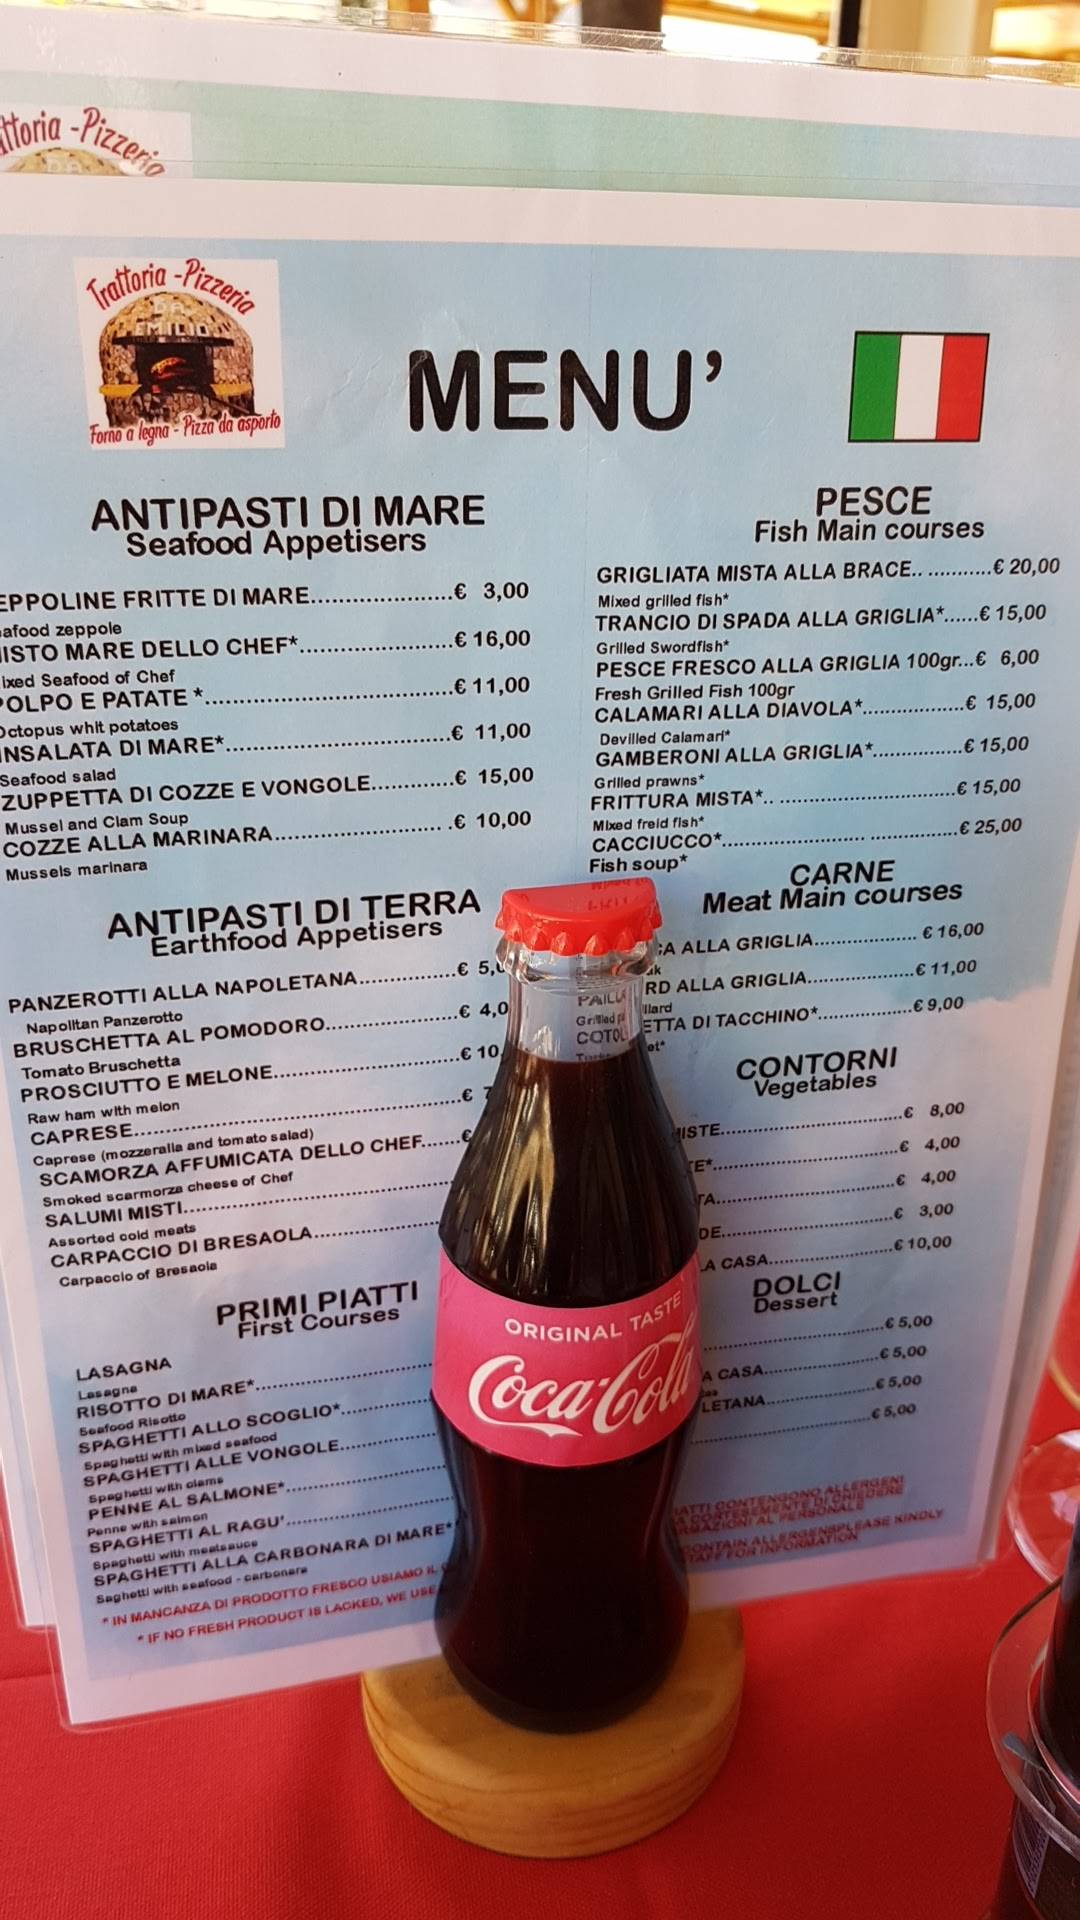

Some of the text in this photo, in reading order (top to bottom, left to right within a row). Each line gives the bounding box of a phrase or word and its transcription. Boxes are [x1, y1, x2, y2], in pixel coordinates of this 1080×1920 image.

[86, 263, 167, 310] Trattoria
[90, 409, 281, 446] Forno legna Pizza da asporto
[91, 494, 485, 532] ANTIPASTI DI MARE
[816, 485, 933, 517] PESCE
[754, 518, 985, 543] Fish Main courses
[126, 528, 427, 561] Seafood Appetisers
[597, 565, 710, 584] GRIGLIATA
[717, 564, 778, 582] MISTA
[783, 563, 837, 581] ALLA
[123, 588, 207, 609] FRITTE
[55, 621, 122, 639] zeppole
[594, 610, 848, 632] TRANCIO SPADA ALLA
[65, 638, 219, 661] MARE DELLO
[41, 668, 176, 687] Seafood Chef
[596, 660, 666, 678] PESCE
[672, 658, 756, 676] FRESCO
[761, 657, 813, 674] ALLA
[819, 654, 900, 672] GRIGLIA
[102, 688, 188, 709] PATATE
[595, 682, 796, 701] Fresh Grilled Fish 100gr
[595, 703, 760, 724] CALAMARI ALLA
[109, 718, 179, 736] potatoes
[595, 746, 776, 768] GAMBERONI ALLA
[0, 767, 116, 788] Seafood salad
[1, 787, 123, 812] ZUPPETTA
[159, 782, 235, 802] COZZE
[591, 792, 689, 811] FRITTURA
[5, 819, 64, 835] Mussel
[67, 816, 98, 831] and
[148, 812, 189, 827] Soup
[3, 837, 82, 858] COZZE
[87, 832, 147, 852] ALLA
[5, 861, 148, 882] Mussels marinara
[790, 859, 896, 887] CARNE
[702, 884, 963, 915] Meat Main courses
[107, 888, 481, 940] ANTIPASTI DI TERRA
[151, 921, 443, 957] Earthfood Appetisers
[681, 938, 730, 955] ALLA
[676, 976, 725, 993] ALLA
[8, 988, 147, 1014] PANZEROTTI
[152, 982, 209, 1002] ALLA
[103, 1011, 183, 1028] Panzerotto
[13, 1032, 161, 1058] BRUSCHETTA
[20, 1055, 181, 1080] Tomato Bruschetta
[736, 1046, 897, 1081] CONTORNI
[20, 1076, 161, 1103] PROSCIUTTO
[754, 1072, 877, 1100] Vegetables
[27, 1101, 180, 1125] Raw ham with melon
[39, 1163, 159, 1187] SCAMORZA
[164, 1148, 294, 1175] AFFUMICATA
[300, 1141, 365, 1161] DELLO
[42, 1192, 102, 1208] Smoked
[187, 1179, 238, 1193] cheese
[260, 1171, 293, 1185] Chef
[45, 1208, 123, 1228] SALUMI
[48, 1223, 196, 1248] Assorted cold meats
[50, 1244, 172, 1268] CARPACCIO
[178, 1239, 198, 1255] DI
[59, 1271, 134, 1287] Carpaccio
[752, 1271, 841, 1298] DOLCI
[216, 1280, 418, 1326] PRIMI PIATTI
[752, 1291, 838, 1314] Dessert
[238, 1308, 400, 1339] First Courses
[505, 1290, 681, 1343] ORIGINAL TASTE
[76, 1357, 172, 1382] LASAGNA
[83, 1460, 190, 1487] SPAGHETTI
[195, 1452, 242, 1471] ALLE
[94, 1538, 369, 1587] SPAGHETTI ALLA CARBONARA
